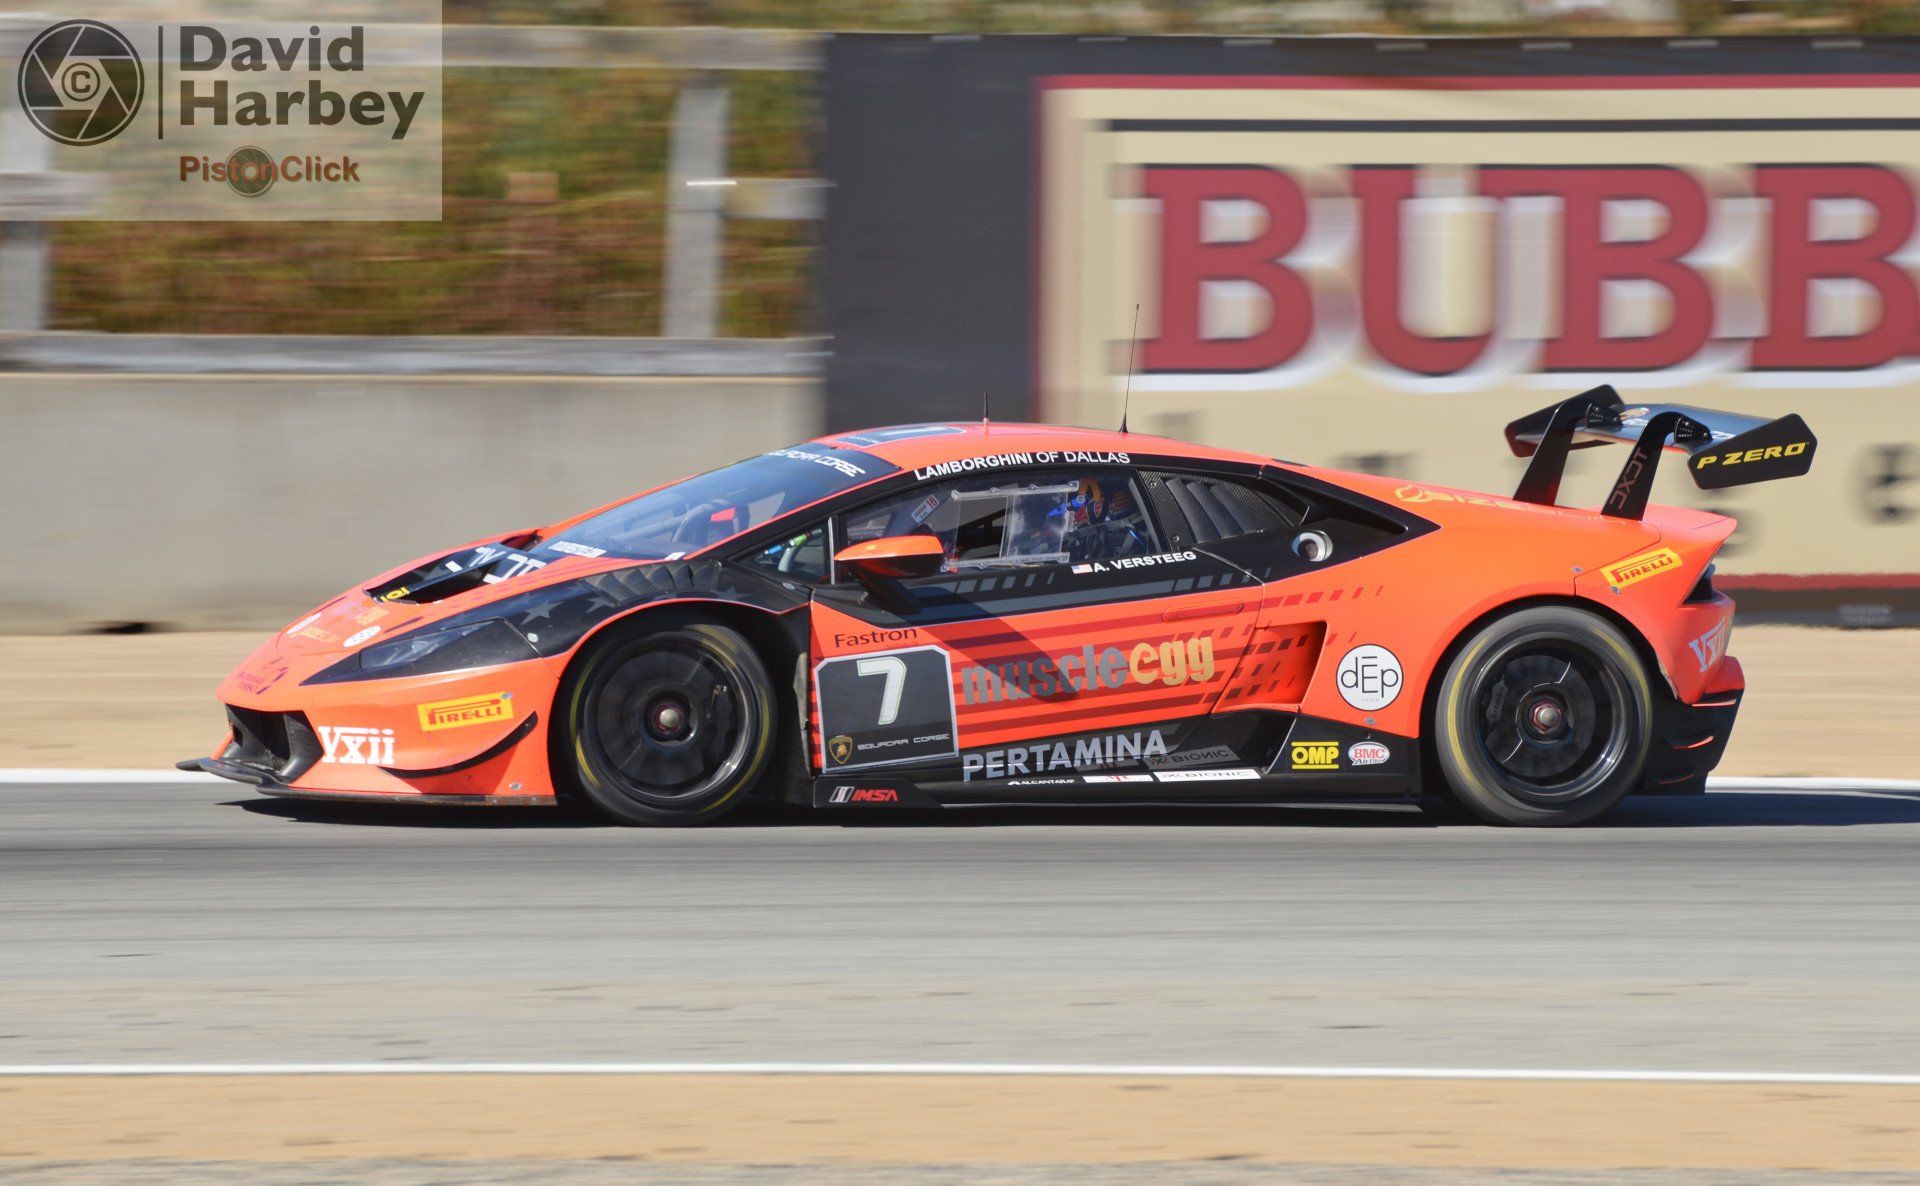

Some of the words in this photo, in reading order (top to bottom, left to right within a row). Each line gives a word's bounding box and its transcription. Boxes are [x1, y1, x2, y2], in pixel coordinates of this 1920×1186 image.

[1141, 163, 1920, 374] BUBB
[913, 452, 1033, 482] LAMBORGHINI
[1036, 451, 1061, 465] OF
[1066, 450, 1131, 464] DALLAS
[1697, 455, 1718, 470] P
[1722, 442, 1806, 466] ZERO
[1093, 561, 1110, 573] A.
[1111, 550, 1197, 571] VERSTEEG
[1612, 552, 1674, 586] PIRELLI
[834, 628, 918, 648] Fastron
[856, 656, 907, 726] 7
[427, 699, 504, 726] PIRELLI
[857, 738, 909, 751] SQUADRA
[913, 733, 950, 744] CORSE
[1291, 745, 1340, 764] OMP
[1354, 748, 1386, 759] BMC
[962, 729, 1169, 783] PERTAMINA
[851, 788, 899, 802] IMSA
